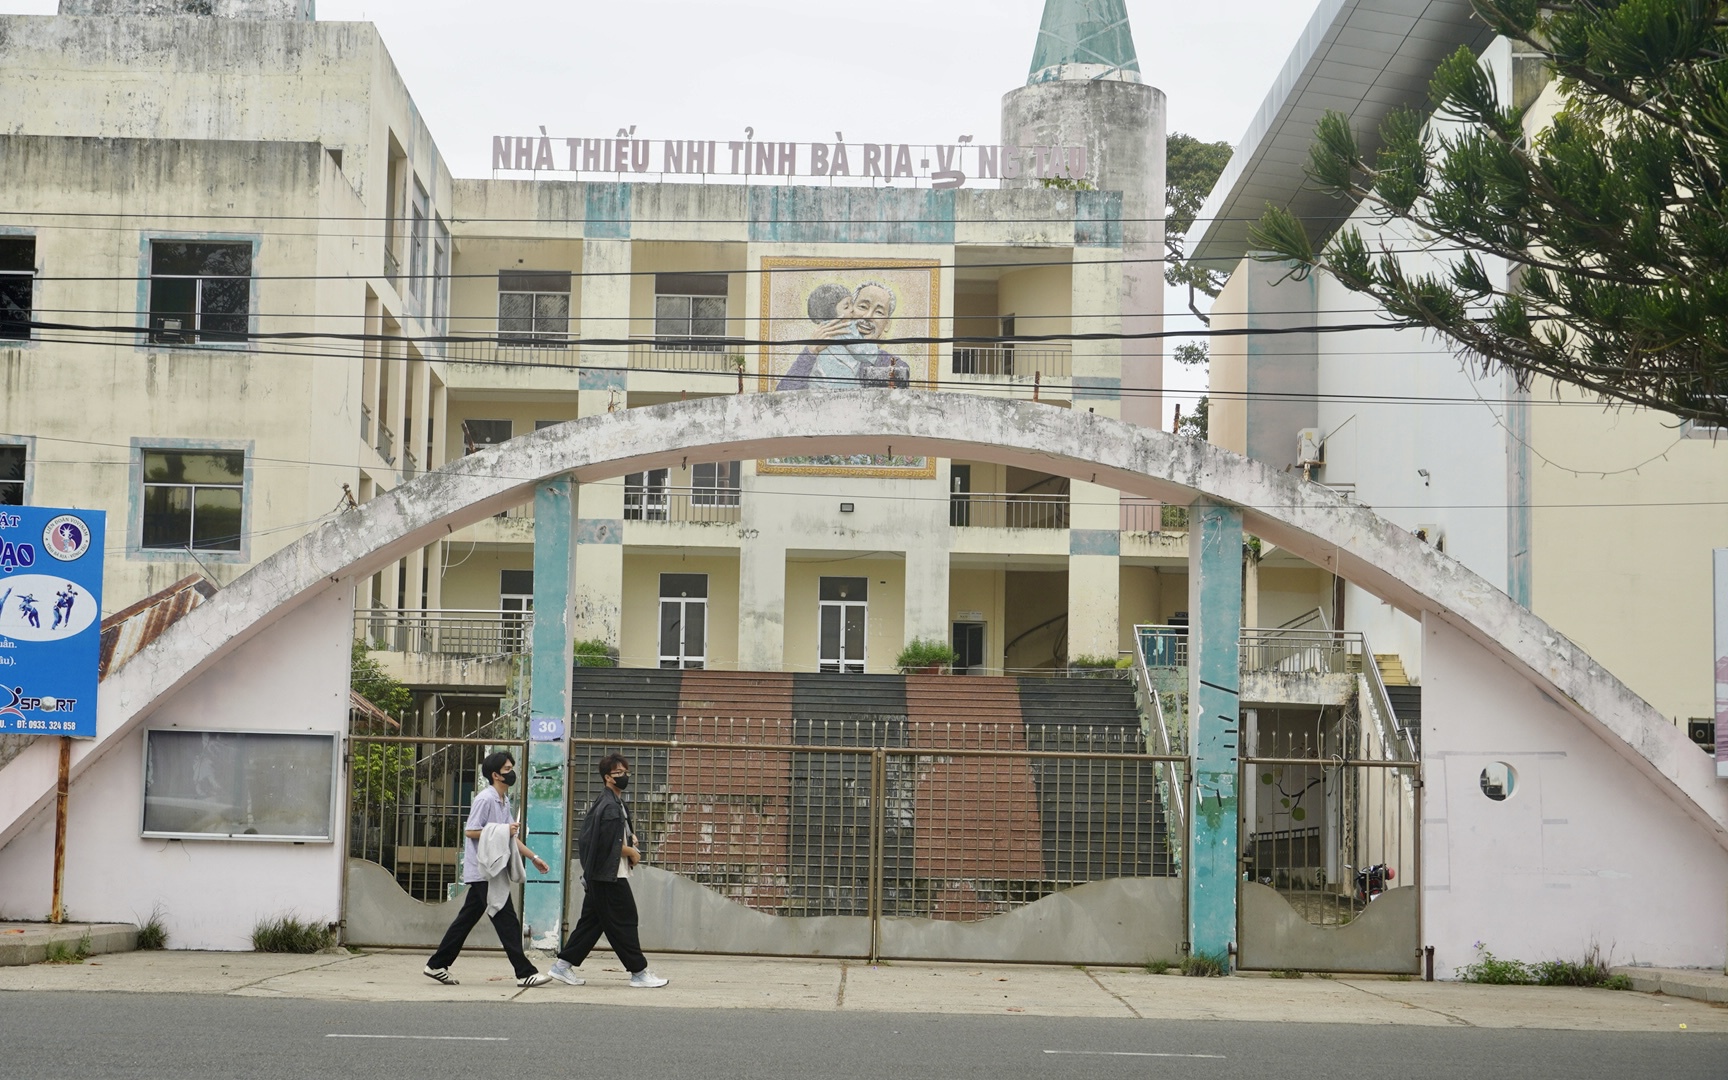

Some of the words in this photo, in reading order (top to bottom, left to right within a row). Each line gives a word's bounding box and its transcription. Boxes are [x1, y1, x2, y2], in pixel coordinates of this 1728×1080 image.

[493, 125, 555, 170] NHÀ
[566, 125, 650, 173] THIẾU
[664, 139, 716, 174] NHI
[728, 126, 796, 176] TỈNH
[810, 131, 851, 176] BÀ
[538, 721, 557, 733] 30
